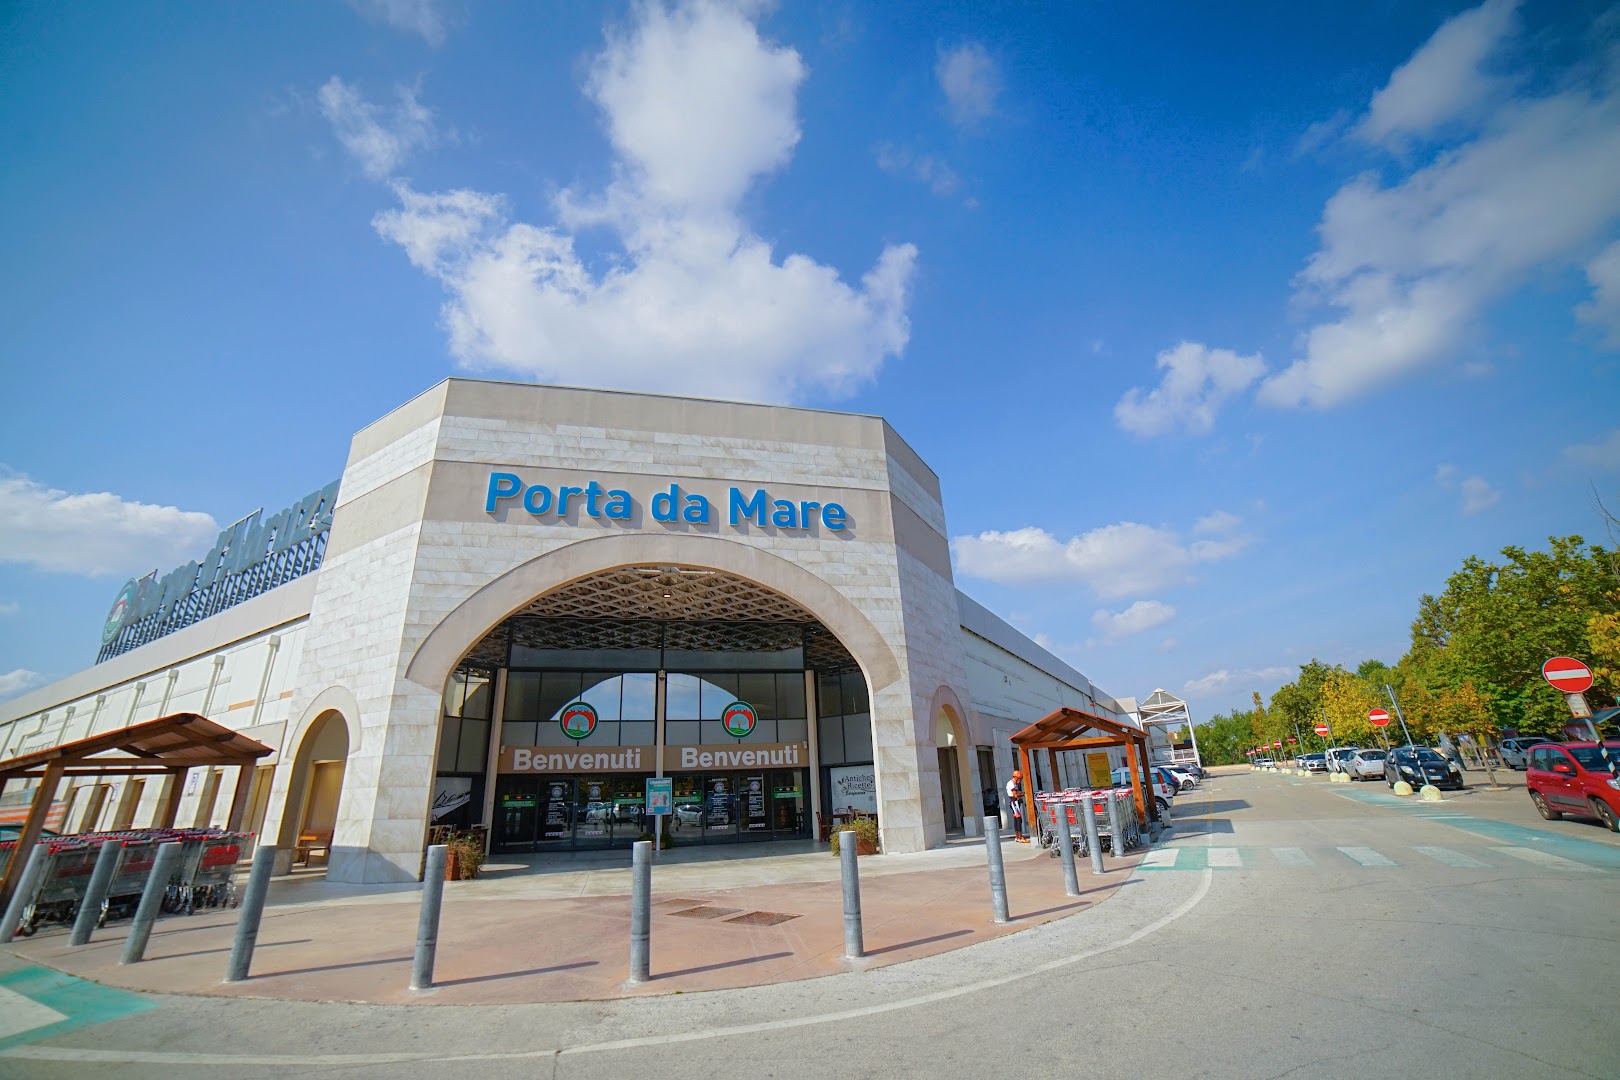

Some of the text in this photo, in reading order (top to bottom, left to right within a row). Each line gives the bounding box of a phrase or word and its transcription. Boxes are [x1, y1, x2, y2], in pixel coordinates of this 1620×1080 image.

[485, 471, 847, 531] Porta da Mare
[513, 748, 641, 771] Benvenuti
[681, 744, 799, 768] Benvenuti
